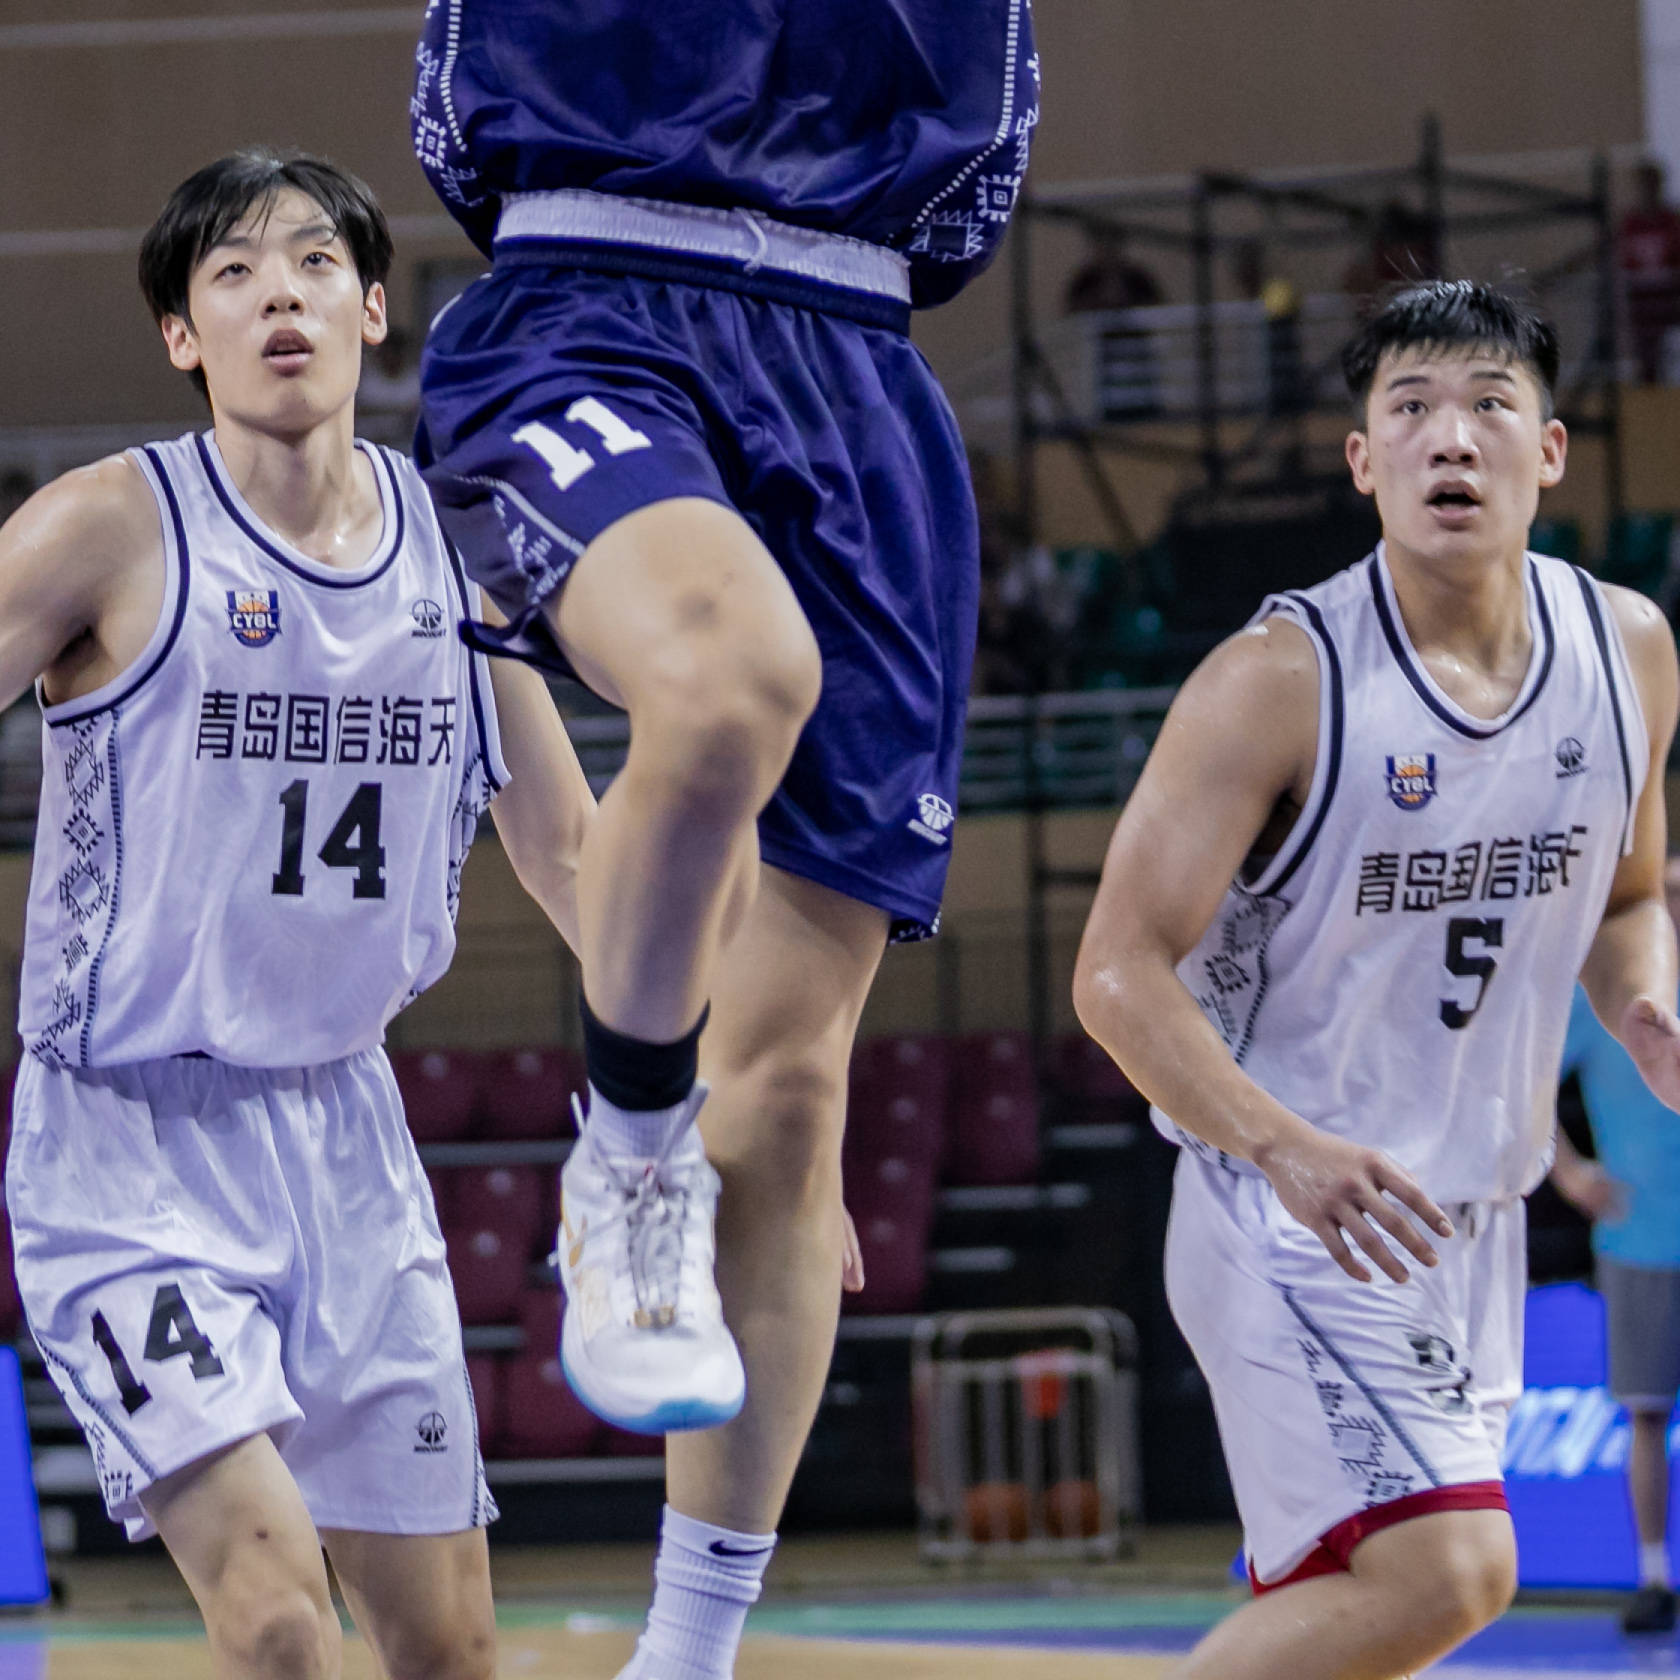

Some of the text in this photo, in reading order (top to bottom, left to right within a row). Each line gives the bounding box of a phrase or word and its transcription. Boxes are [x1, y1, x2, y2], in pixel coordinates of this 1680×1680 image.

[512, 395, 652, 491] 11
[233, 613, 277, 628] CYBL
[196, 690, 456, 766] 青岛国信海天
[271, 778, 386, 900] 14
[1439, 917, 1504, 1030] 5
[91, 1283, 224, 1415] 14
